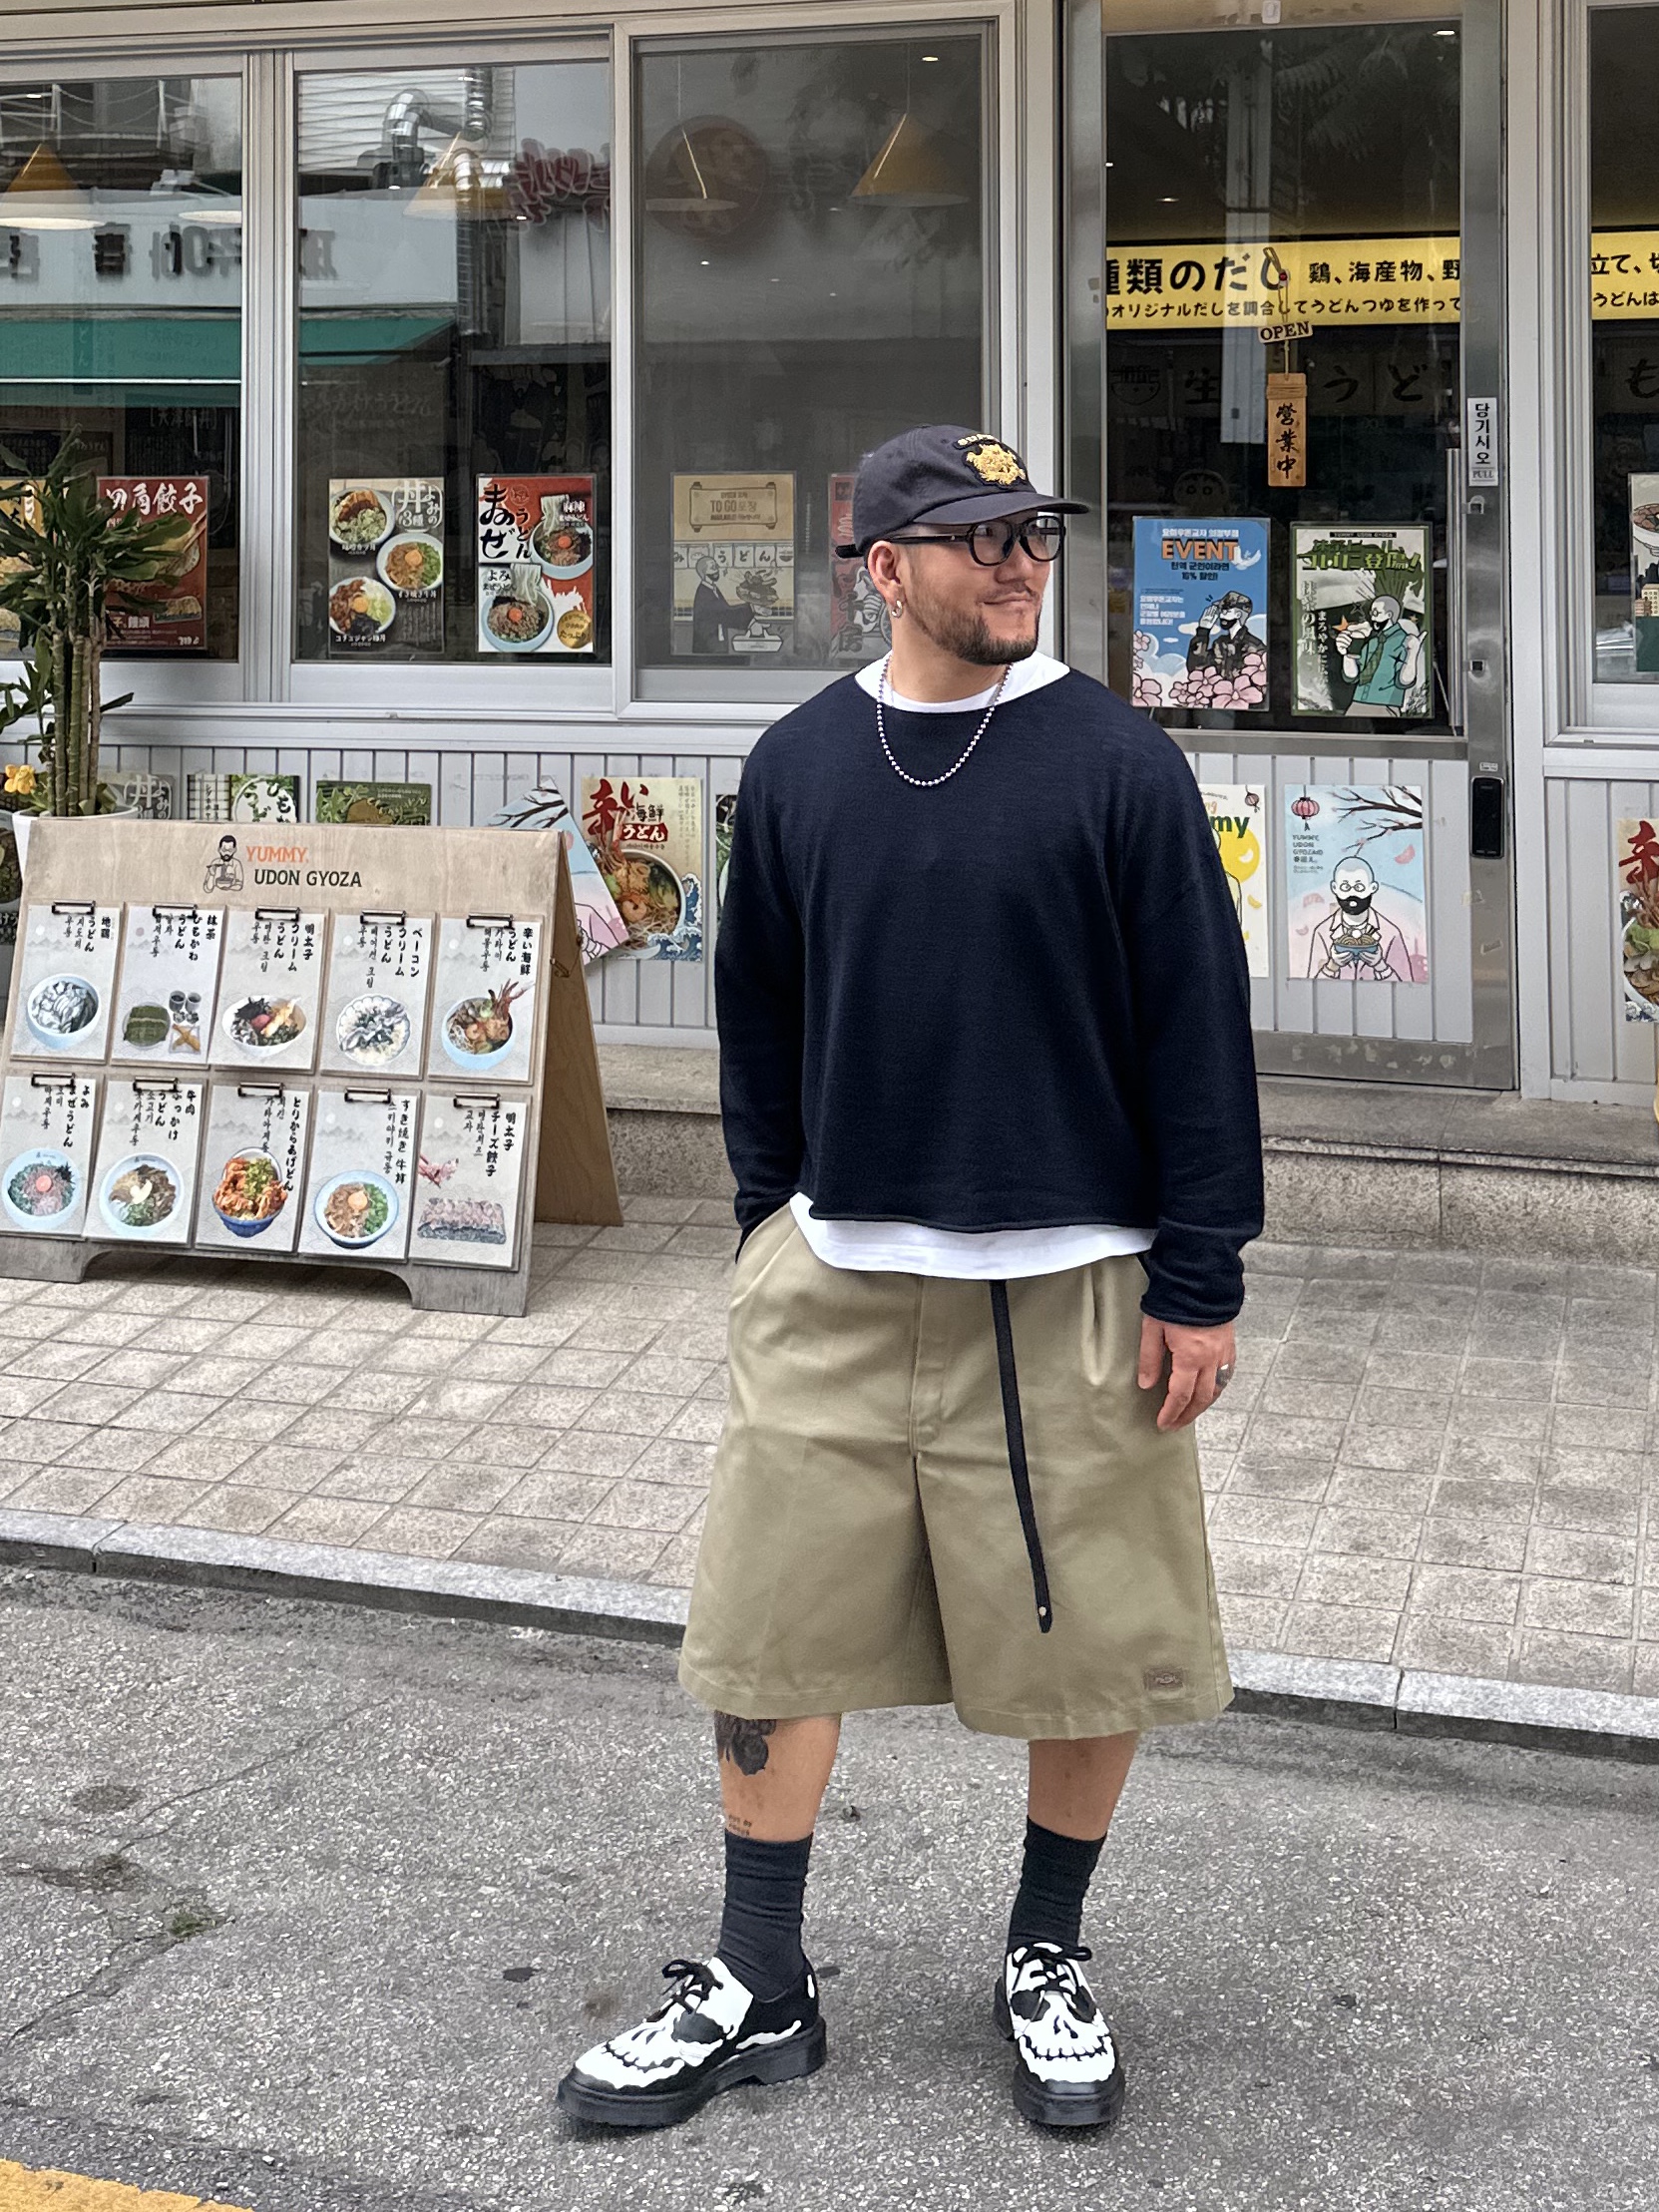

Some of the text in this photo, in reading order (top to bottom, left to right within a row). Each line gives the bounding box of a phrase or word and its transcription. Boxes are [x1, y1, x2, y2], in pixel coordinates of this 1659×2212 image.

[1106, 296, 1459, 318] オリジナルだしを調合してうどんつゆを作って
[1260, 321, 1310, 343] OPEN
[1275, 402, 1299, 481] 営業中
[1474, 402, 1491, 465] 당기시오
[1472, 470, 1494, 479] PULL
[710, 500, 722, 513] TO
[724, 500, 737, 513] GO
[516, 508, 533, 559] うどん
[1162, 539, 1238, 561] EVENT
[488, 569, 512, 582] よみ
[622, 824, 666, 842] うどん
[246, 845, 309, 863] YUMMY.
[254, 869, 362, 888] UDON GYOZA
[84, 916, 96, 952] うどん
[273, 922, 286, 959] うどん
[381, 925, 393, 963] うどん
[287, 923, 300, 972] クリーム
[395, 927, 407, 977] クリーム
[410, 928, 423, 977] ベーコン
[80, 1085, 90, 1108] よみ
[463, 1109, 473, 1132] 교자
[504, 1111, 516, 1151] 明太子
